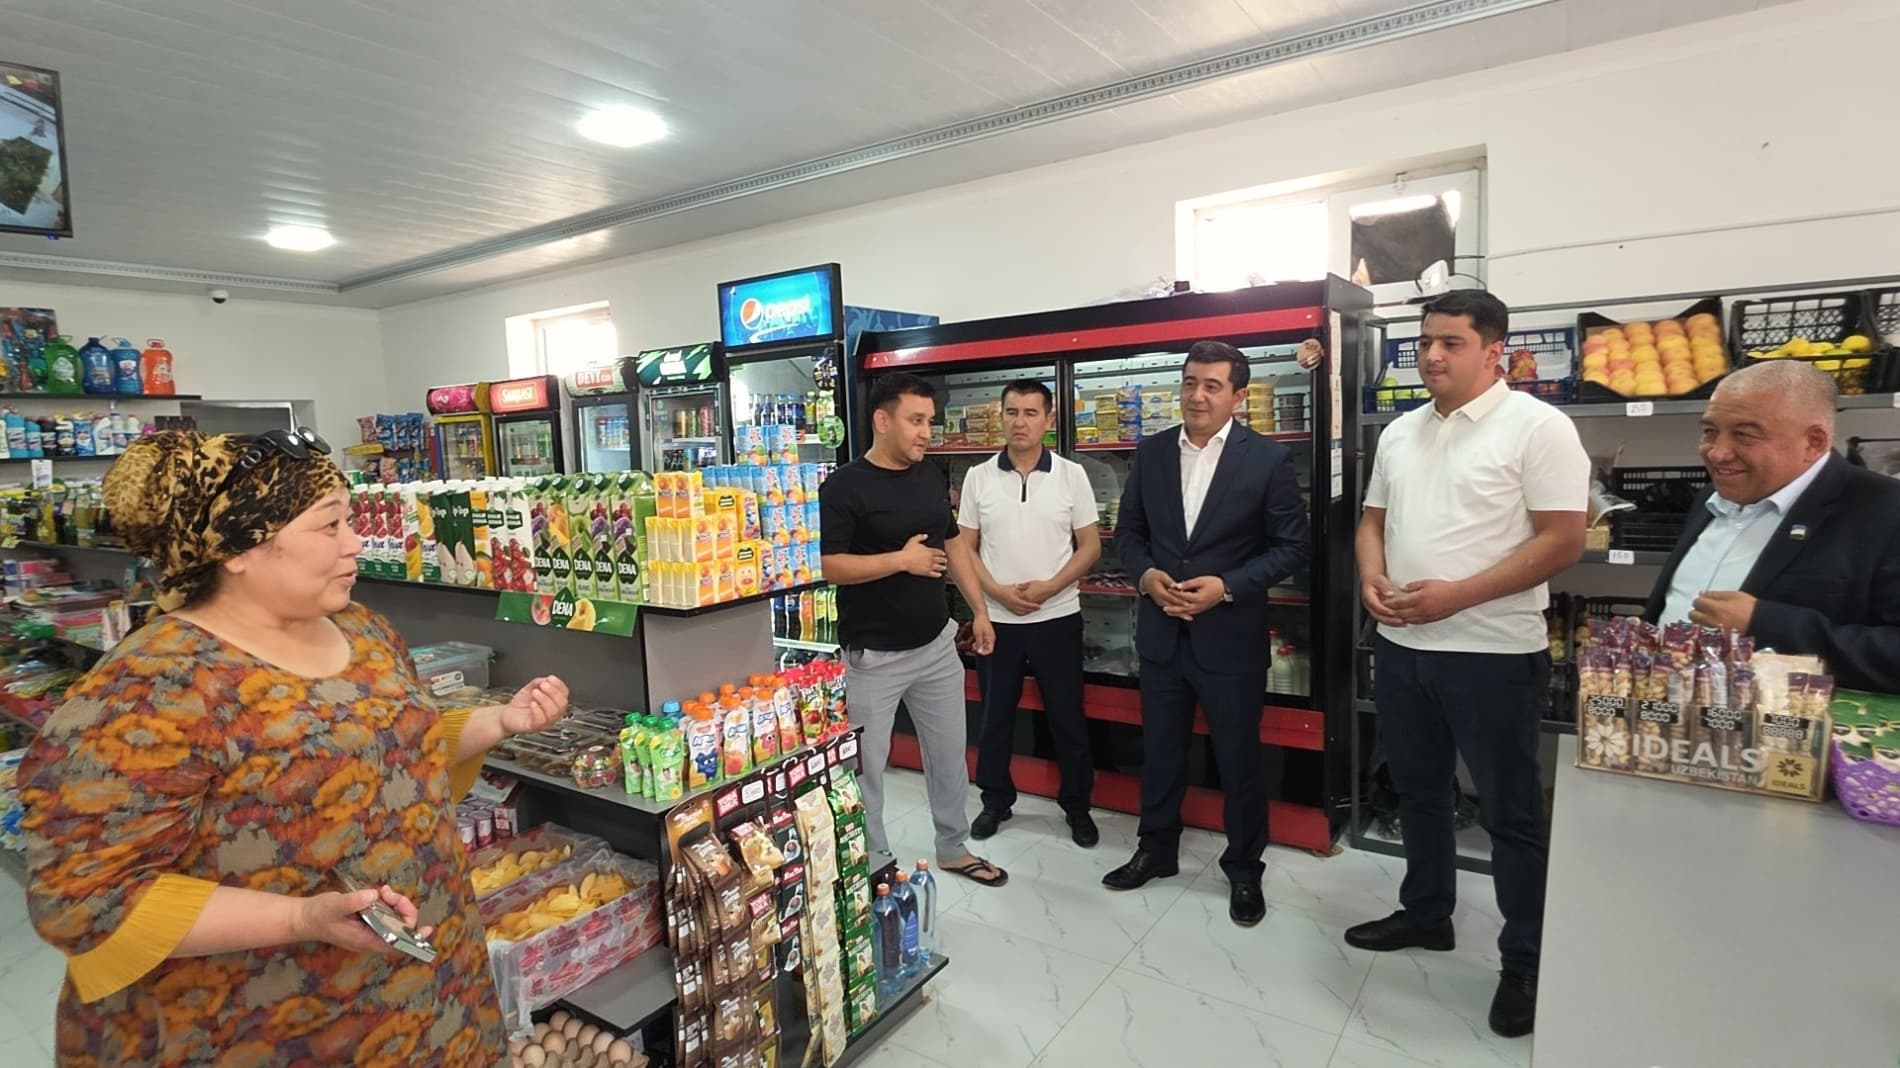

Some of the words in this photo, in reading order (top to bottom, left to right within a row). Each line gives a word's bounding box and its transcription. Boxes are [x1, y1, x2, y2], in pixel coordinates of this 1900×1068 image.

[553, 557, 570, 570] DENA
[574, 559, 592, 572] DENA
[595, 561, 613, 574] DENA
[617, 562, 637, 576] DENA
[551, 600, 574, 616] DENA
[1671, 764, 1758, 786] UZBEKISTAN
